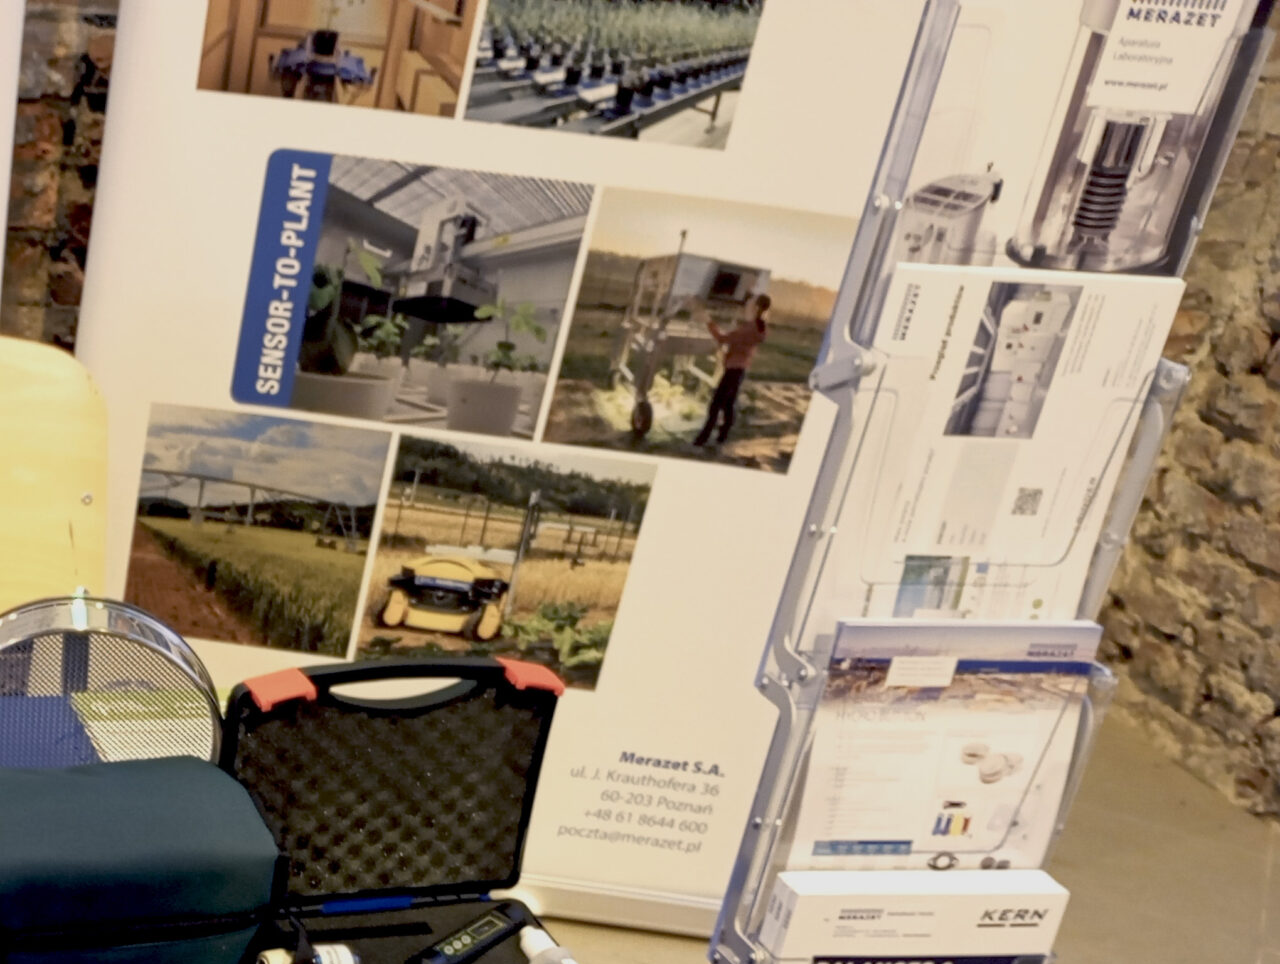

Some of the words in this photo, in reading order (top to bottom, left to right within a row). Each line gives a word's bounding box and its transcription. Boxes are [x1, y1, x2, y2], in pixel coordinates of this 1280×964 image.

[1127, 7, 1221, 27] MERAZET
[255, 162, 318, 396] SENSOR-TO-PLANT
[619, 750, 690, 774] Merazet
[692, 760, 726, 779] S.A.
[569, 765, 588, 780] ul.
[590, 770, 602, 782] J.
[606, 769, 697, 795] Krauthofera
[701, 782, 721, 797] 36
[599, 788, 653, 808] 60-203
[656, 797, 714, 816] Poznań
[584, 808, 613, 822] +48
[614, 811, 633, 824] 61
[678, 820, 709, 836] 600
[556, 823, 703, 854] poczta@merazet.pl
[980, 908, 1049, 923] KERN
